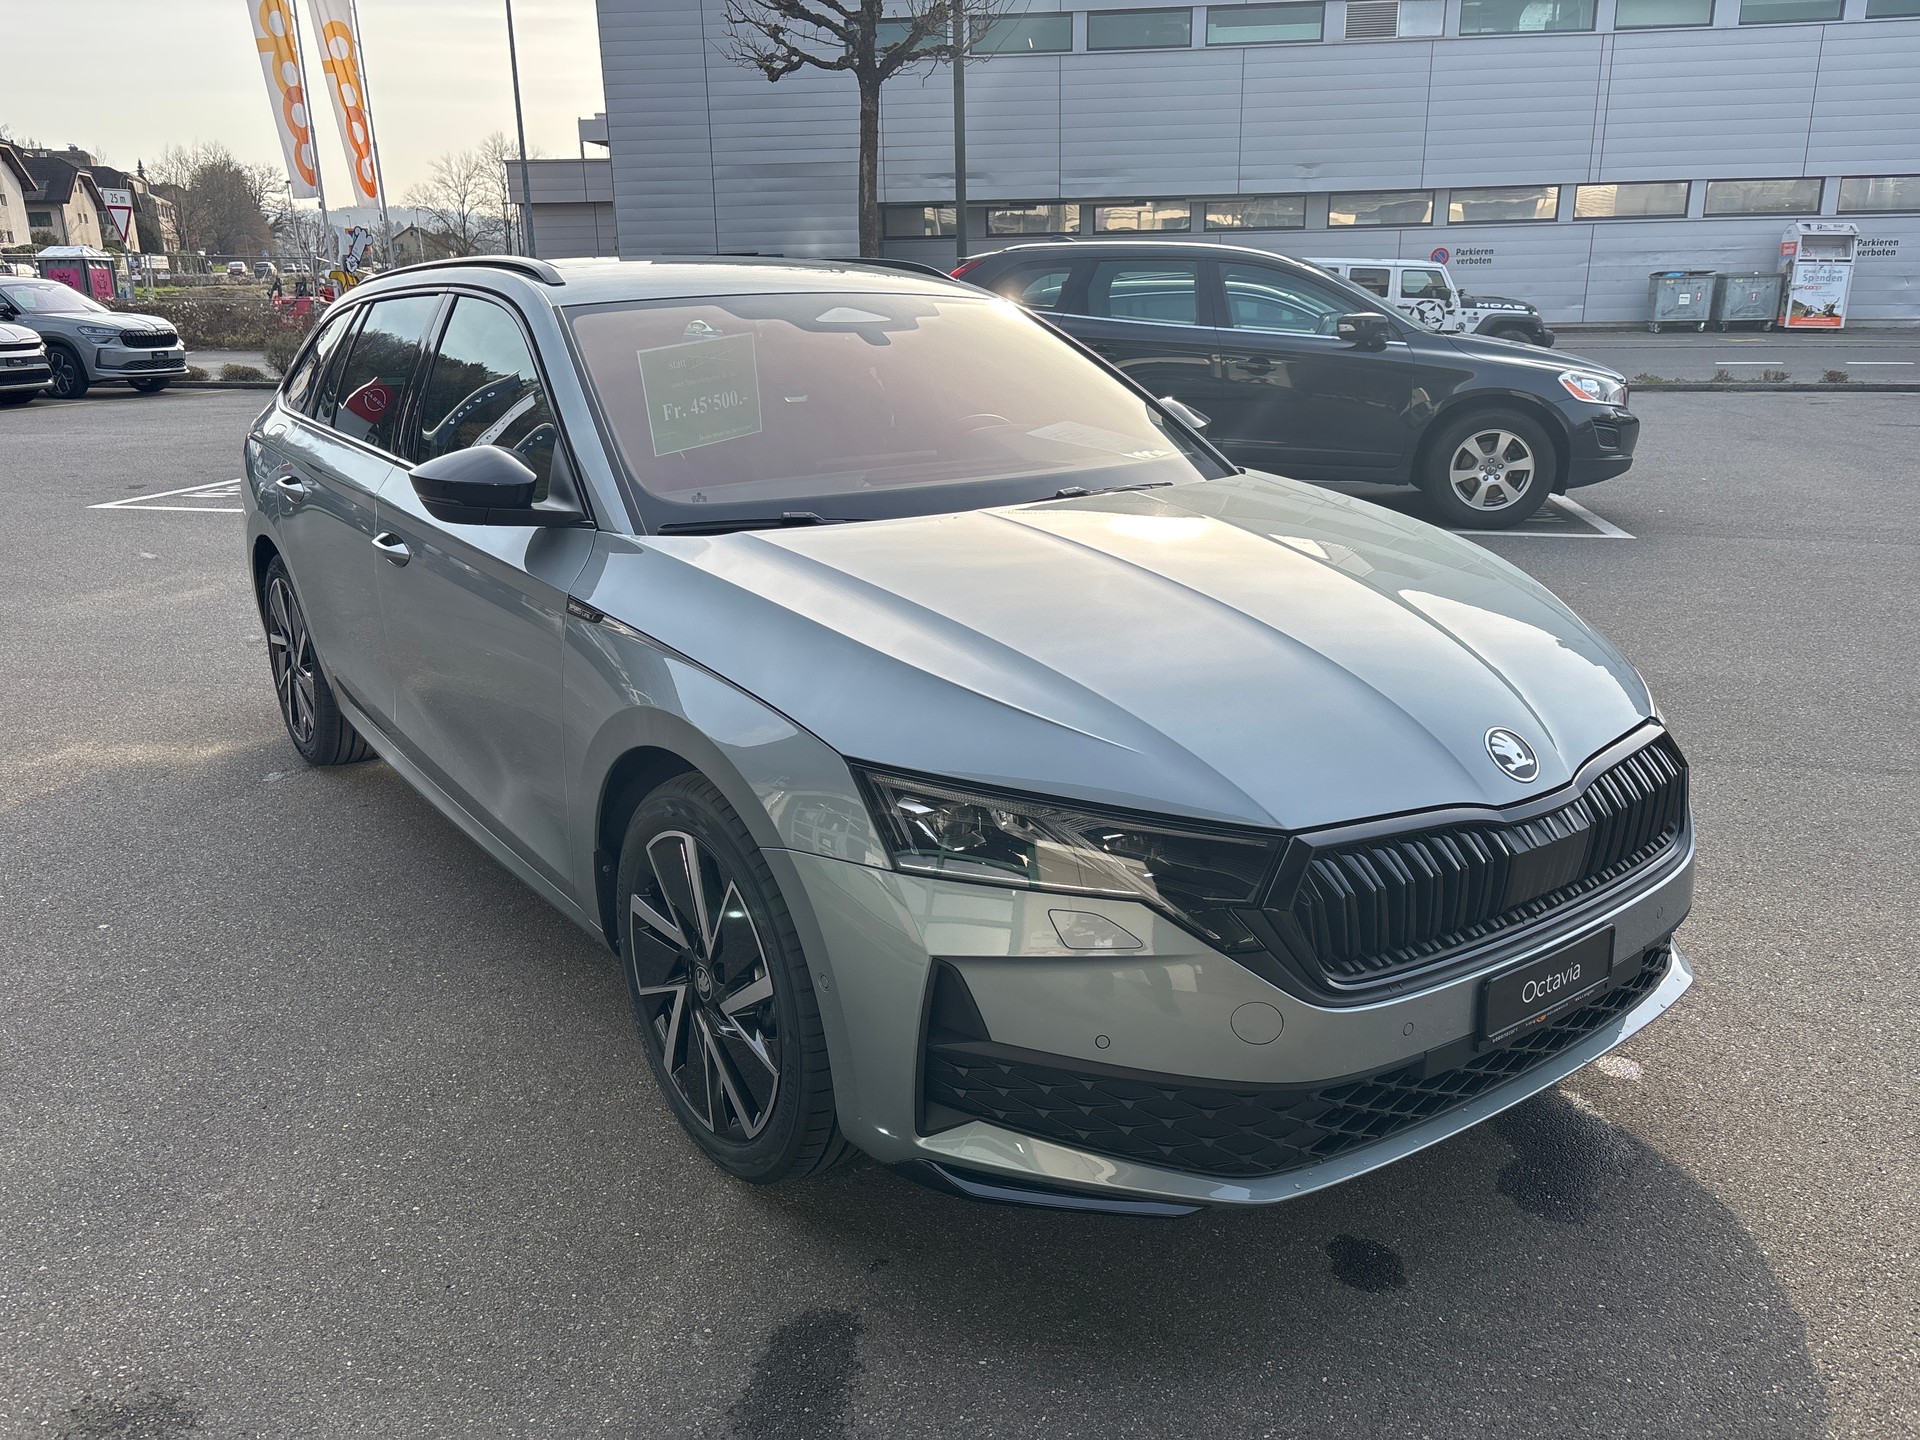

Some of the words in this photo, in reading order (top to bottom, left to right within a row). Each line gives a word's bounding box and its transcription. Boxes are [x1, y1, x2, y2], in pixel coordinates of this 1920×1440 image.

[110, 193, 118, 203] 25
[1857, 238, 1899, 247] Parkieren
[1456, 248, 1494, 256] Parkieren
[1857, 248, 1896, 256] verboten
[1456, 256, 1492, 265] verboten
[1476, 302, 1526, 310] MOAB
[448, 391, 496, 425] VOLVO
[662, 403, 687, 421] Fr.
[1522, 961, 1581, 1003] Octavia
